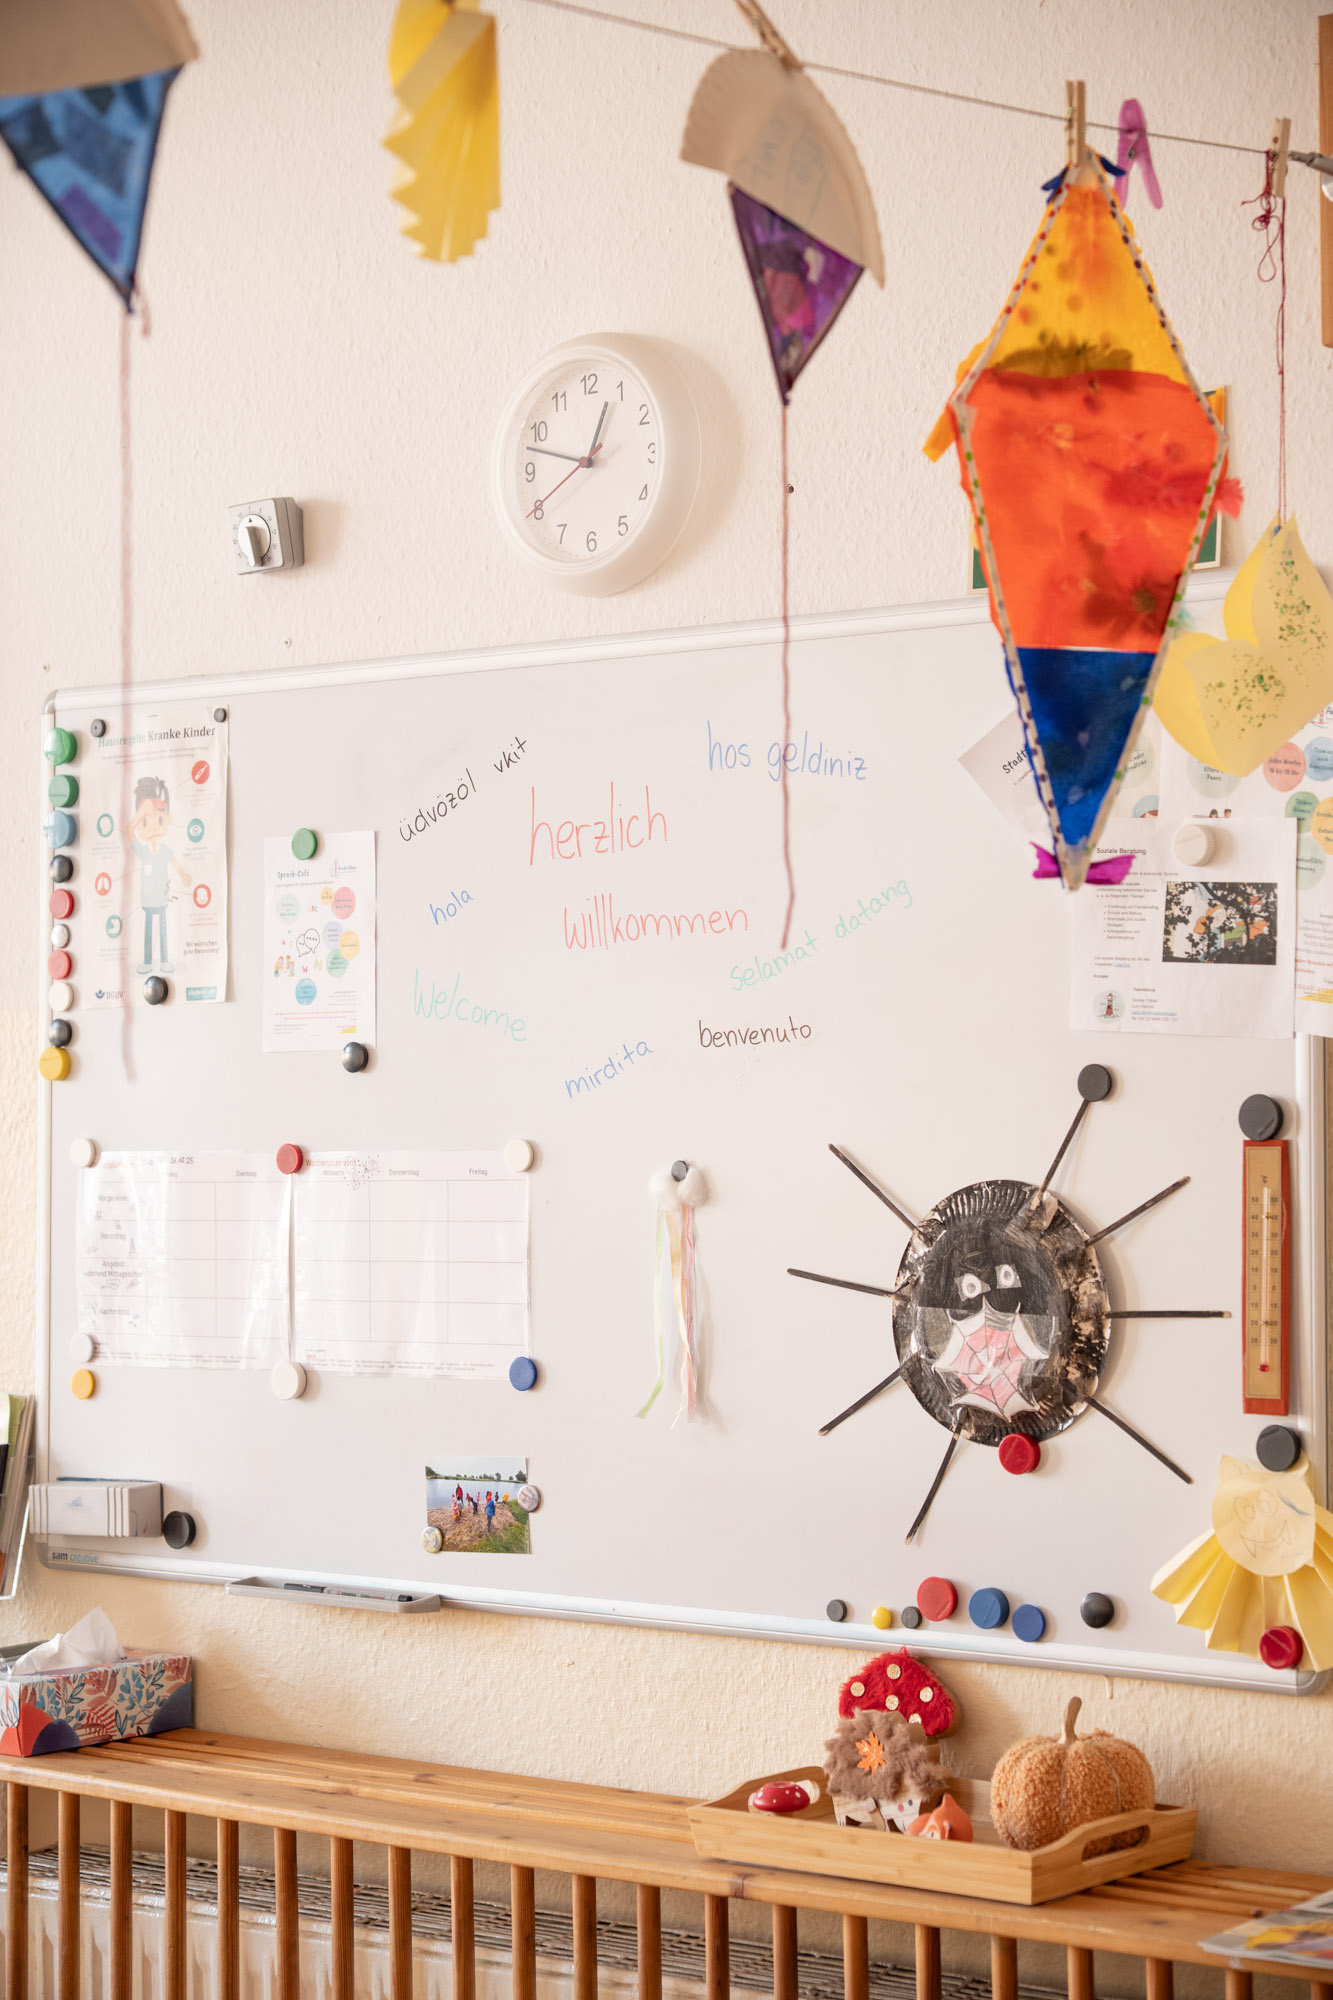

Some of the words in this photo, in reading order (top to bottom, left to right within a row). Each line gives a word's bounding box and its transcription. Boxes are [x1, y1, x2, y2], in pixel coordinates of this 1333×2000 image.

[580, 373, 598, 395] 12
[616, 380, 624, 402] 1
[552, 390, 567, 412] 11
[639, 404, 650, 426] 2
[530, 421, 548, 442] 10
[647, 442, 656, 464] 3
[525, 462, 536, 482] 9
[639, 484, 648, 500] 4
[534, 500, 544, 520] 8
[557, 524, 568, 544] 7
[618, 515, 628, 536] 5
[586, 531, 598, 552] 6
[148, 728, 181, 742] Kranke
[183, 725, 216, 738] Kinder
[707, 720, 751, 772] hos
[768, 730, 868, 782] geldiniz
[399, 768, 476, 842] üdvözöl
[494, 736, 527, 773] vkit
[530, 781, 668, 866] herzlich
[429, 887, 474, 926] hola
[834, 879, 913, 939] datang
[414, 969, 528, 1042] Welcome
[699, 1016, 812, 1048] benvenuto
[565, 1040, 654, 1098] mirdita
[388, 1168, 420, 1177] Donnerstag
[468, 1168, 488, 1176] Freitag
[52, 1552, 68, 1560] sam
[70, 1553, 99, 1563] creative
